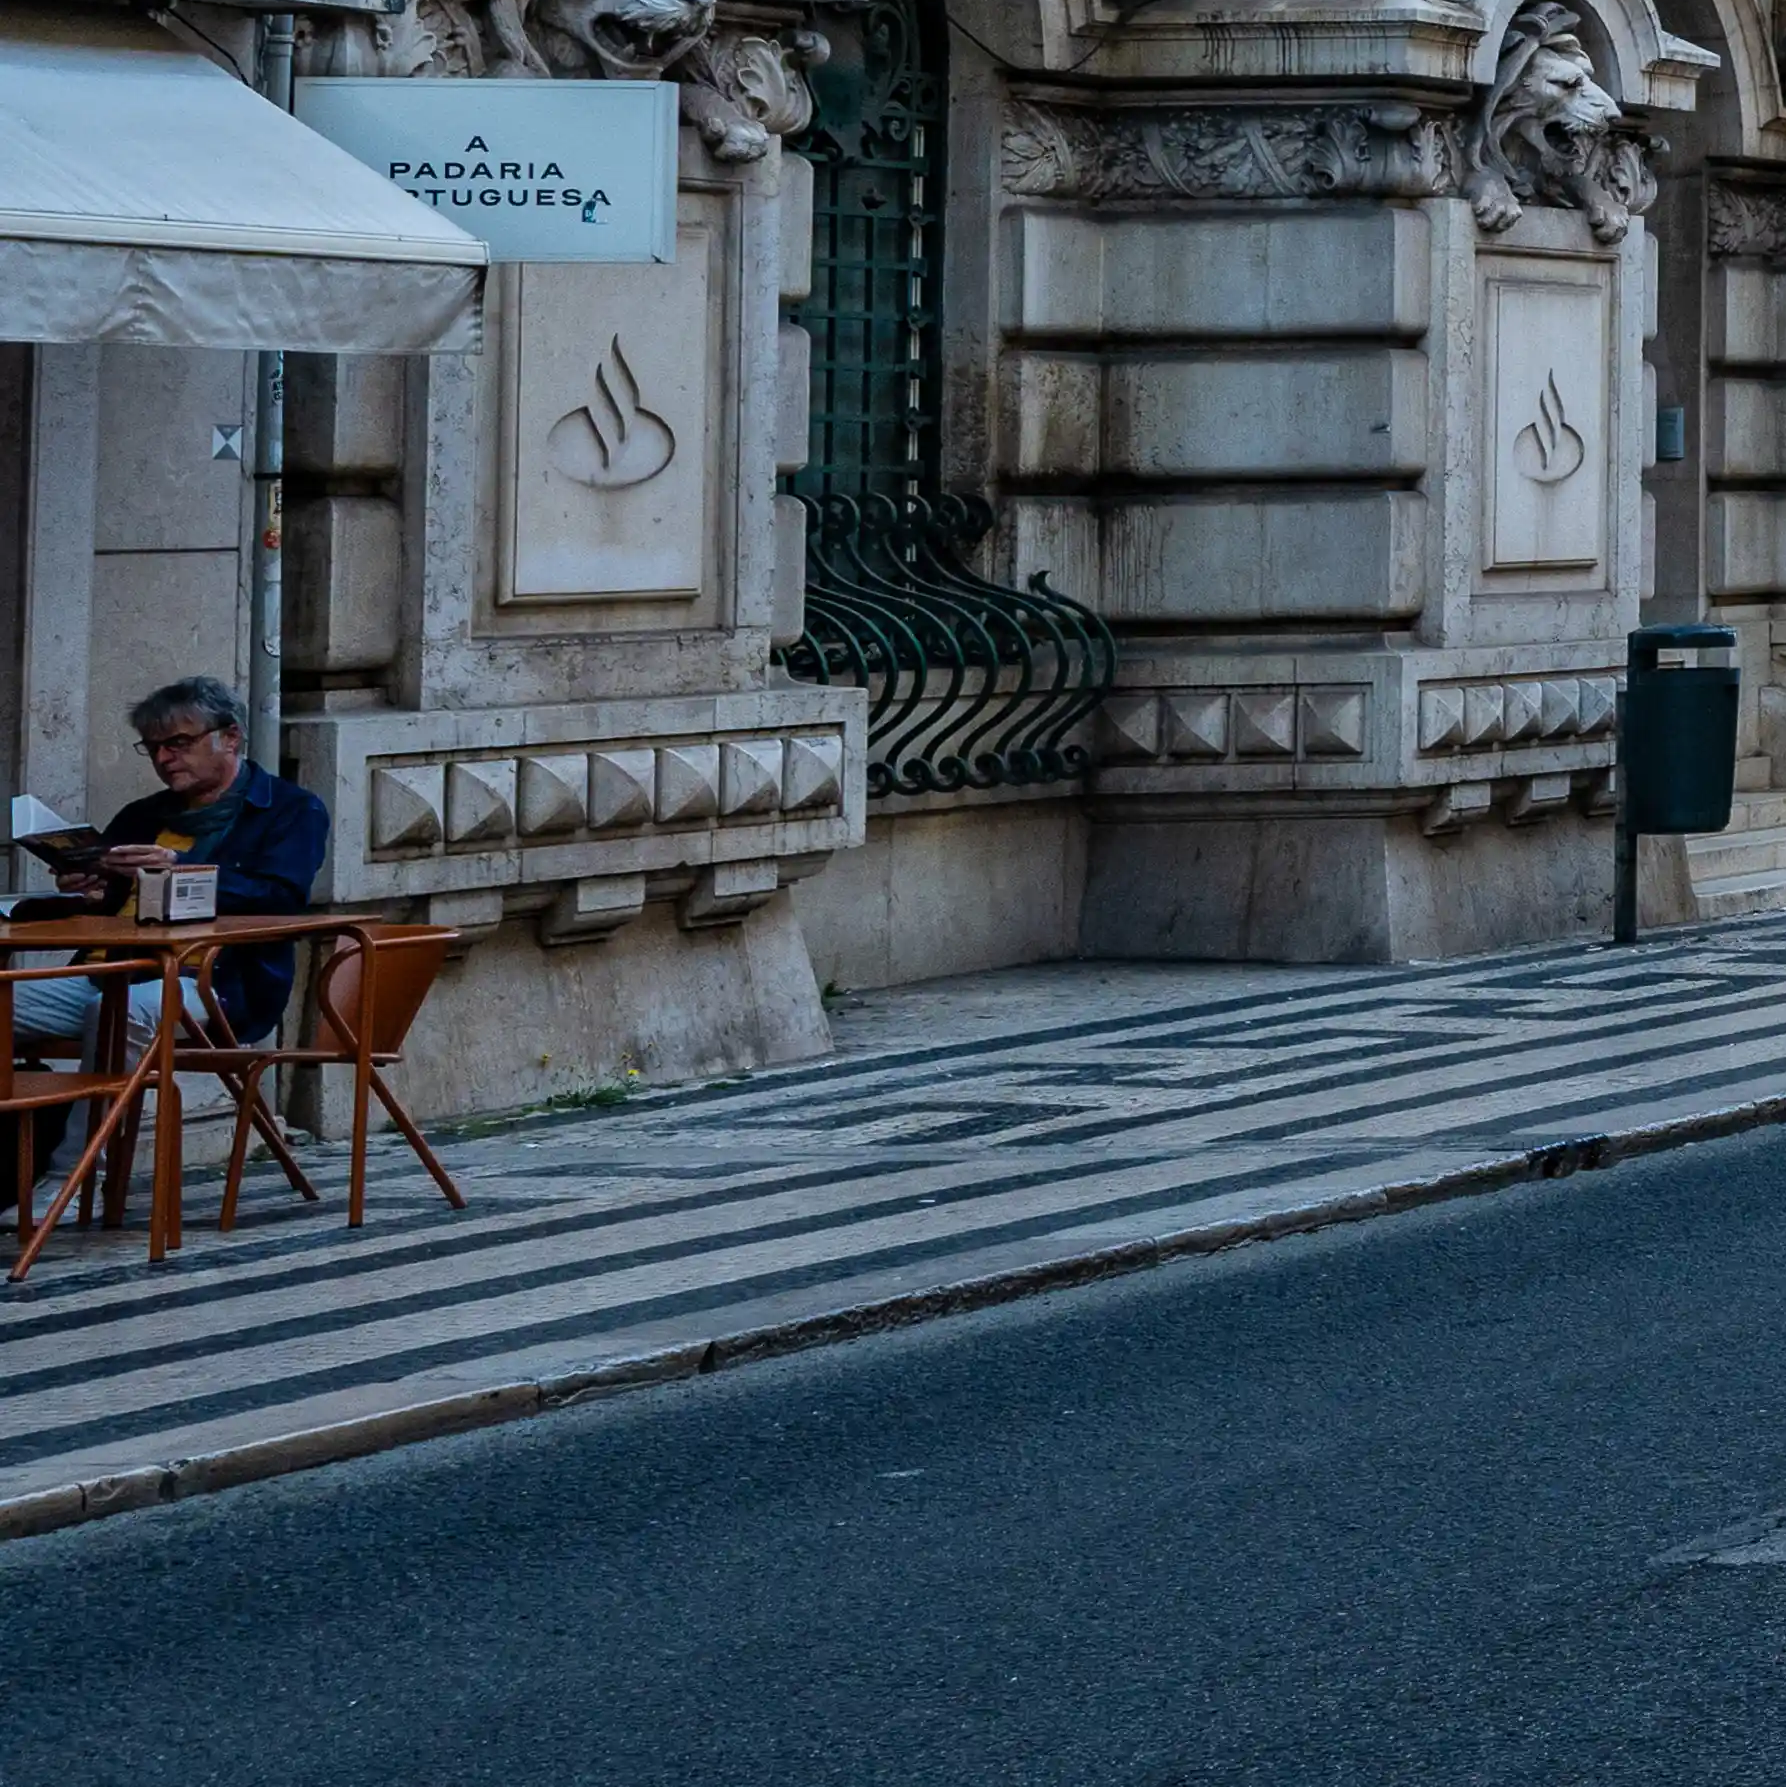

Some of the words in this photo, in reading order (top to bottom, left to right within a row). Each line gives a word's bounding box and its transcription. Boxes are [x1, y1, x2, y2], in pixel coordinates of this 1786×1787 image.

[465, 135, 489, 153] A
[389, 162, 565, 180] PADARIA
[404, 189, 611, 207] TUGUESA
